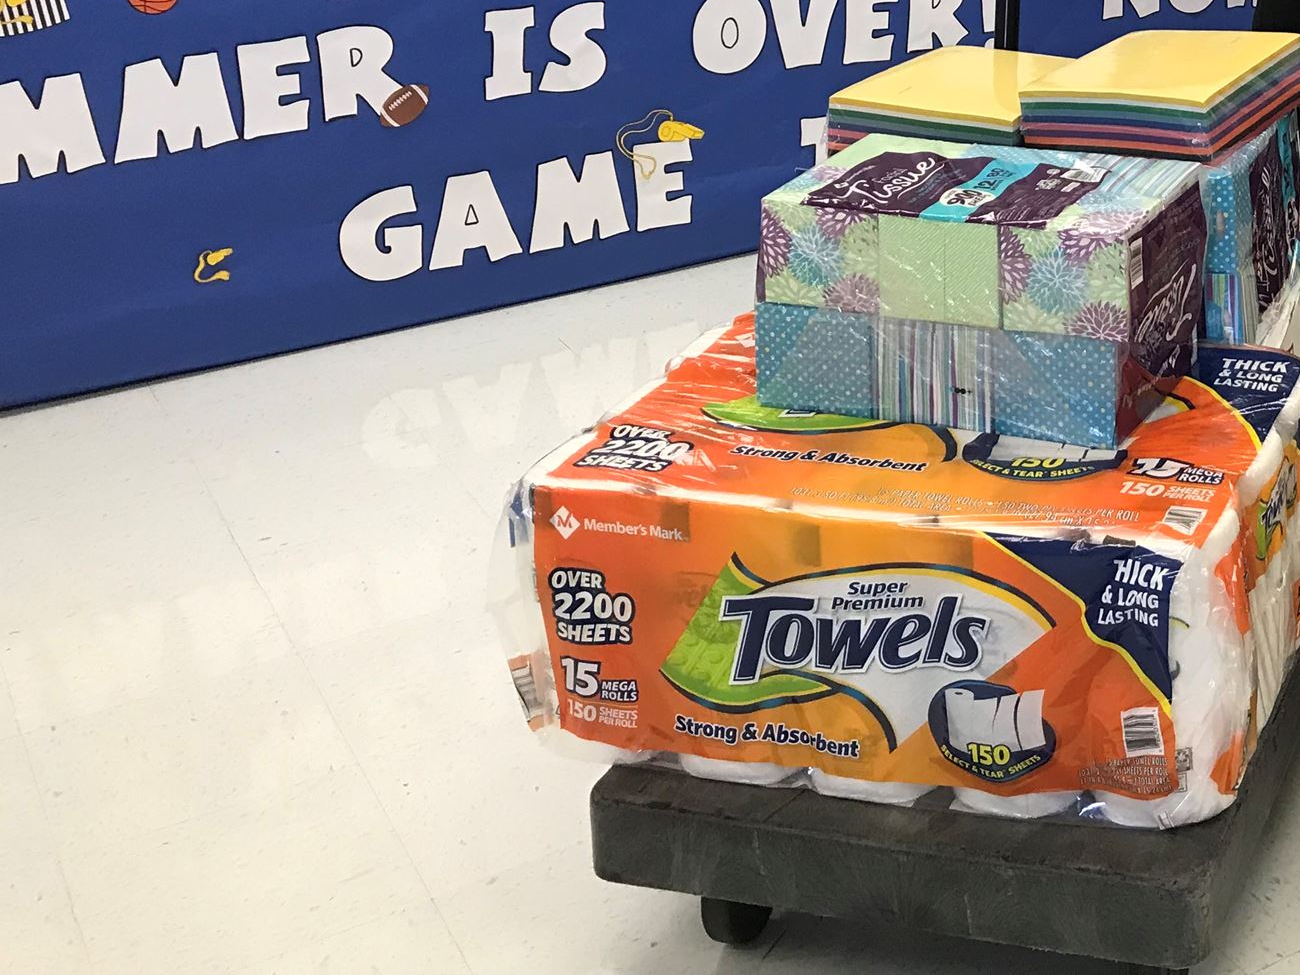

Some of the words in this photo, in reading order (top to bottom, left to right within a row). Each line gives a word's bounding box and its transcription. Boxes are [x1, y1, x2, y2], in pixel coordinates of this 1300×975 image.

[485, 1, 607, 101] IS
[836, 157, 936, 204] Tissue
[339, 140, 694, 282] GAME
[1221, 358, 1291, 374] THICK
[1213, 377, 1279, 393] LASTING
[1218, 368, 1232, 377] &
[1236, 370, 1284, 384] LONG
[613, 424, 672, 440] OVER
[597, 438, 686, 461] 2200
[731, 444, 800, 462] Strong
[800, 448, 816, 461] &
[818, 451, 928, 473] Absorbent
[580, 454, 673, 472] SHEETS
[1011, 456, 1066, 468] 150
[1013, 469, 1044, 478] TEAR
[1179, 474, 1223, 485] ROLLS
[1183, 465, 1225, 478] MEGA
[1120, 480, 1166, 498] 150
[1167, 485, 1217, 498] SHEETS
[1115, 509, 1142, 522] ROLL
[584, 518, 648, 537] Member's
[650, 527, 683, 541] Mark
[551, 570, 603, 589] OVER
[847, 580, 908, 598] Super
[1101, 584, 1112, 604] &
[1118, 588, 1159, 609] LONG
[554, 591, 633, 622] 2200
[831, 594, 924, 611] Premium
[1097, 608, 1159, 627] LASTING
[557, 622, 631, 643] SHEETS
[720, 595, 989, 685] Towels
[561, 657, 599, 697] 15
[601, 681, 637, 692] MEGA
[601, 690, 638, 702] ROLLS
[567, 698, 597, 722] 150
[599, 707, 638, 720] SHEETS
[598, 716, 615, 727] PER
[615, 718, 638, 729] ROLL
[674, 713, 738, 744] Strong
[741, 722, 760, 741] &
[762, 722, 861, 759] Absorbent
[940, 744, 970, 768] SELECT
[971, 764, 980, 773] &
[980, 767, 1004, 779] TEAR
[1008, 754, 1042, 774] SHEETS
[966, 742, 1012, 766] 150
